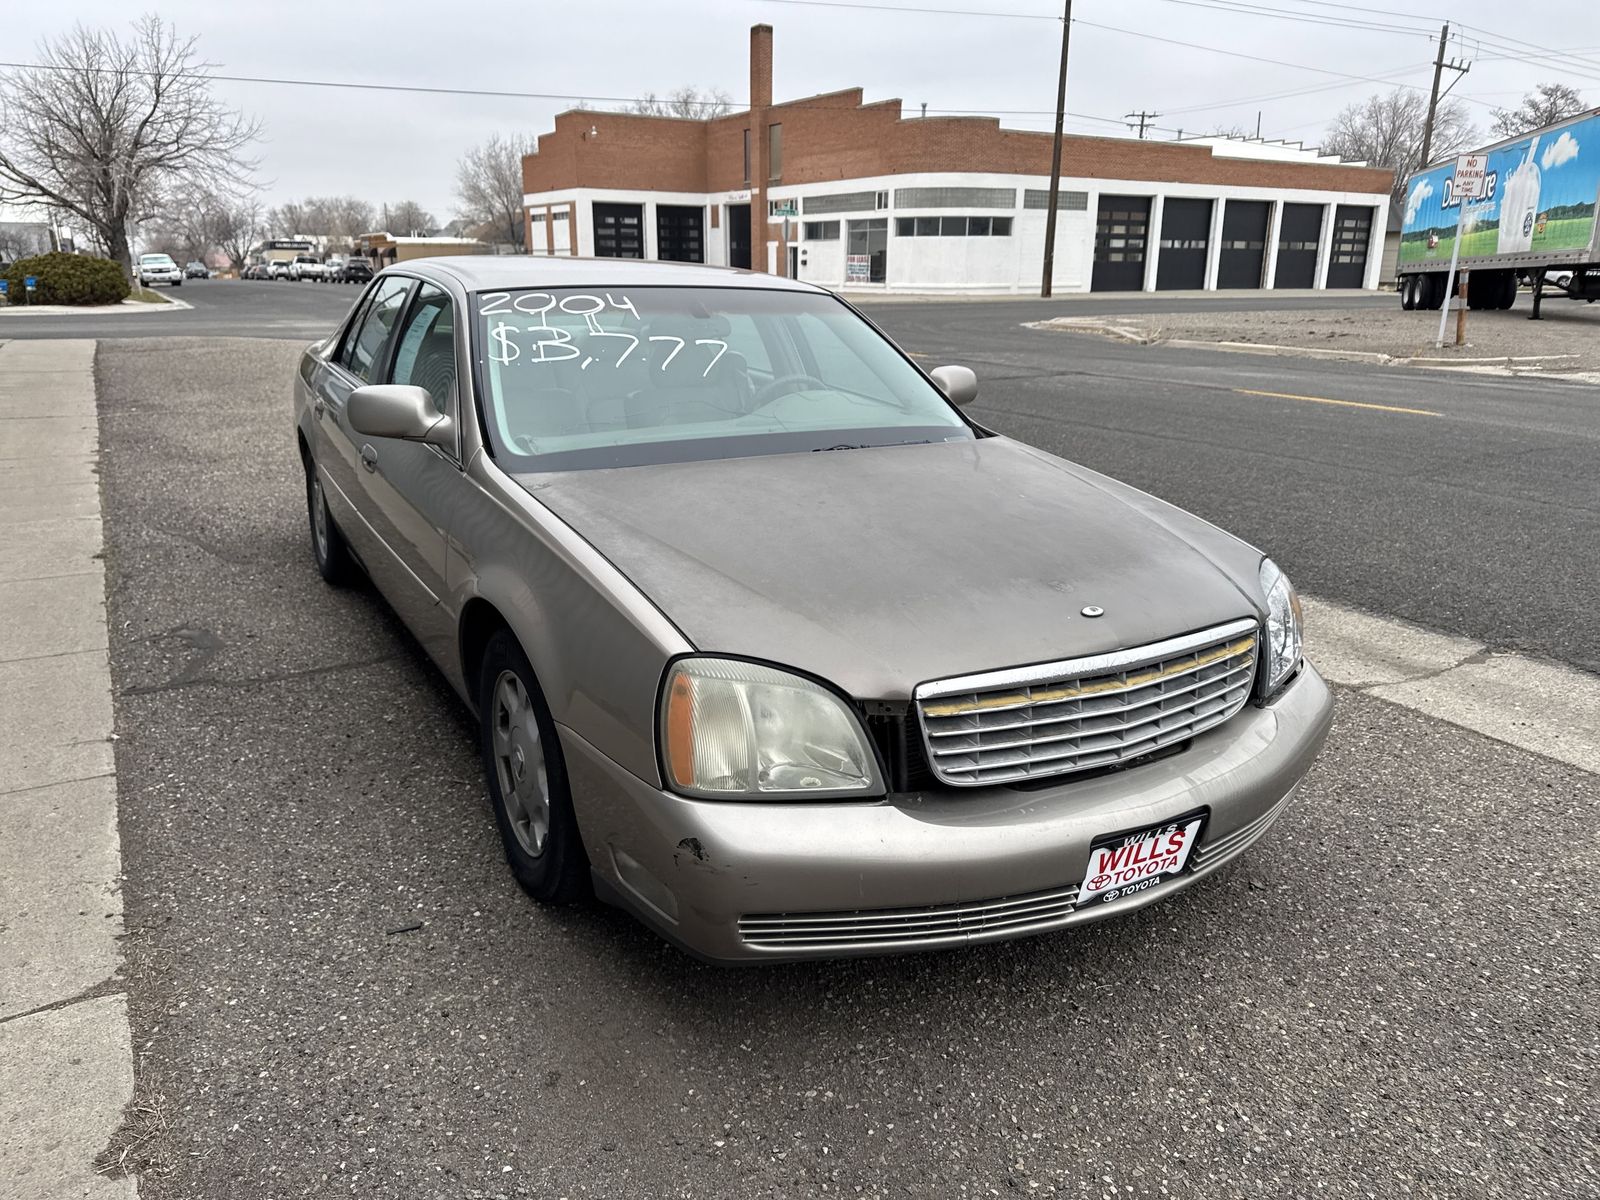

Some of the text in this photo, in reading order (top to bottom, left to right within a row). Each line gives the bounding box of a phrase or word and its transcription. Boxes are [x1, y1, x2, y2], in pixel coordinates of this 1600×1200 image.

[1456, 170, 1484, 178] PARKING
[1466, 159, 1478, 168] NO
[480, 292, 640, 320] 2004
[1123, 824, 1178, 847] WILLS
[1099, 831, 1186, 874] WILLS
[1114, 856, 1178, 885] TOYOTA
[1121, 876, 1160, 897] TOYOTA
